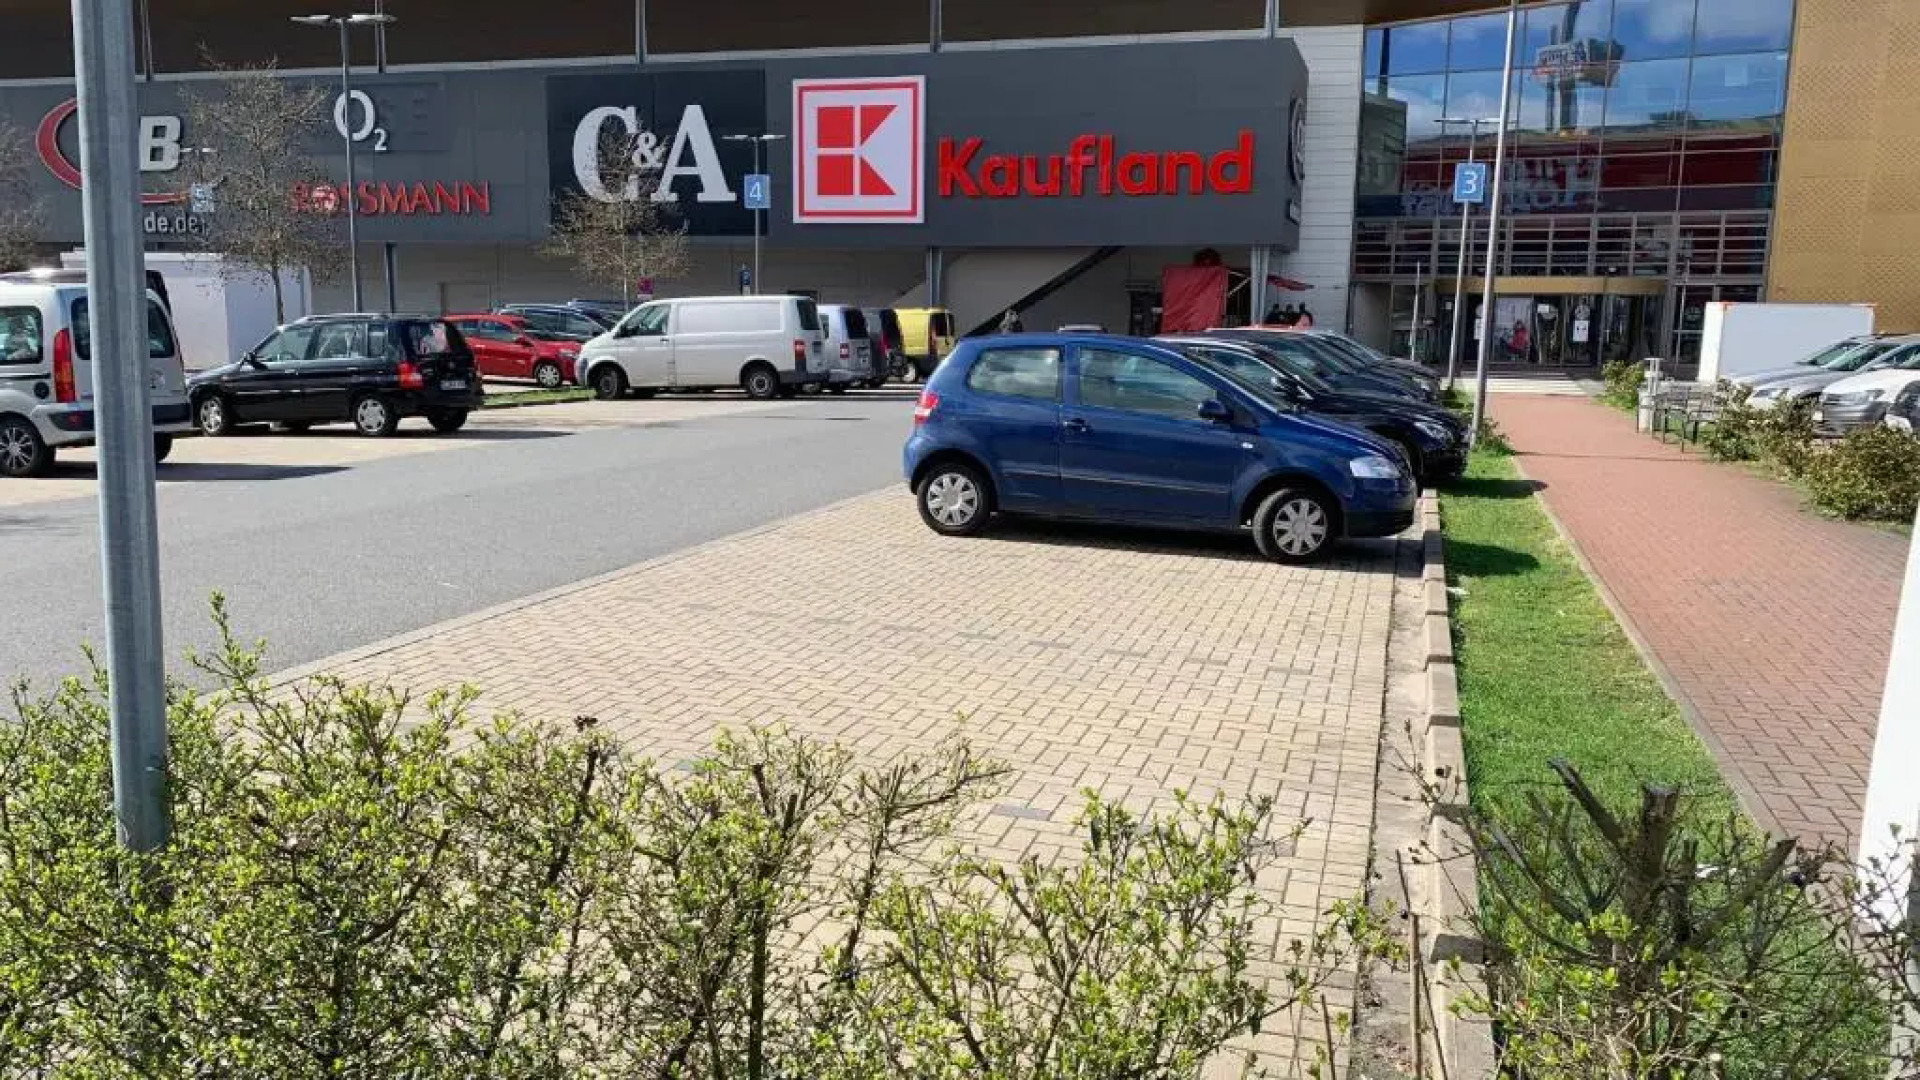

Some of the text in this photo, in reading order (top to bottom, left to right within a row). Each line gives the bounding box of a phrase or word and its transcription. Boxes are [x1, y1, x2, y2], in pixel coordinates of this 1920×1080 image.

[573, 104, 737, 202] C&A
[938, 129, 1255, 197] Kaufland
[749, 182, 763, 201] 4
[1463, 171, 1478, 194] 3
